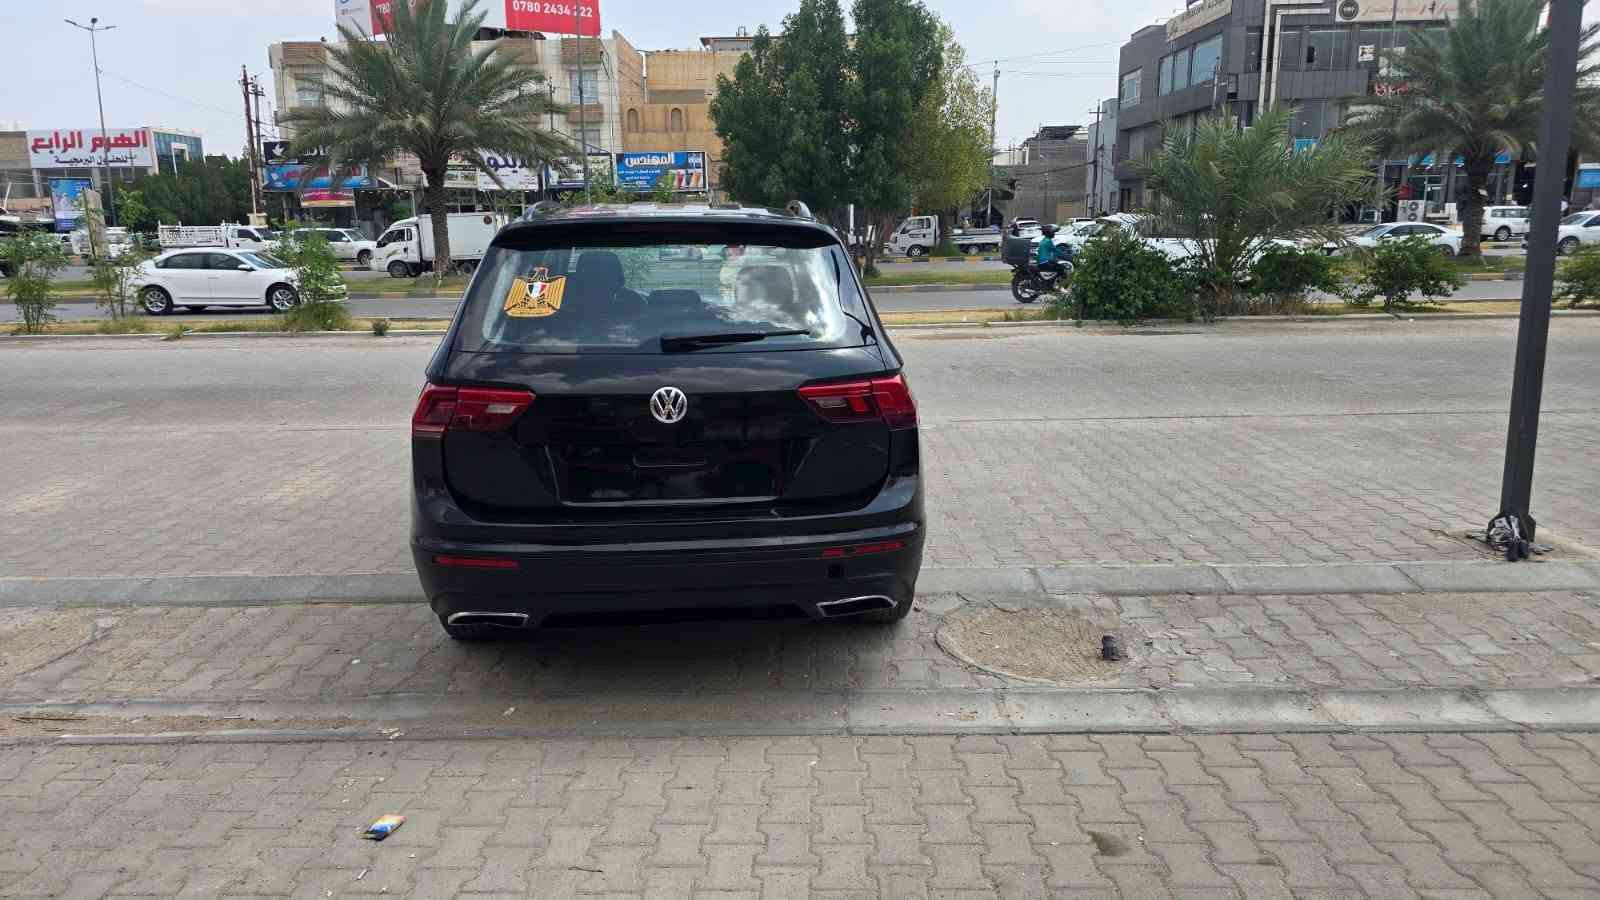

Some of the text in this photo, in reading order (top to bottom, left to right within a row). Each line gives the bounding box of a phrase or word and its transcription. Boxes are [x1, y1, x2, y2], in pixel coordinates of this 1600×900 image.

[512, 0, 541, 13] 0780
[543, 3, 571, 16] 2434
[31, 130, 148, 154] الهرم الرابع
[625, 152, 675, 167] المهندس
